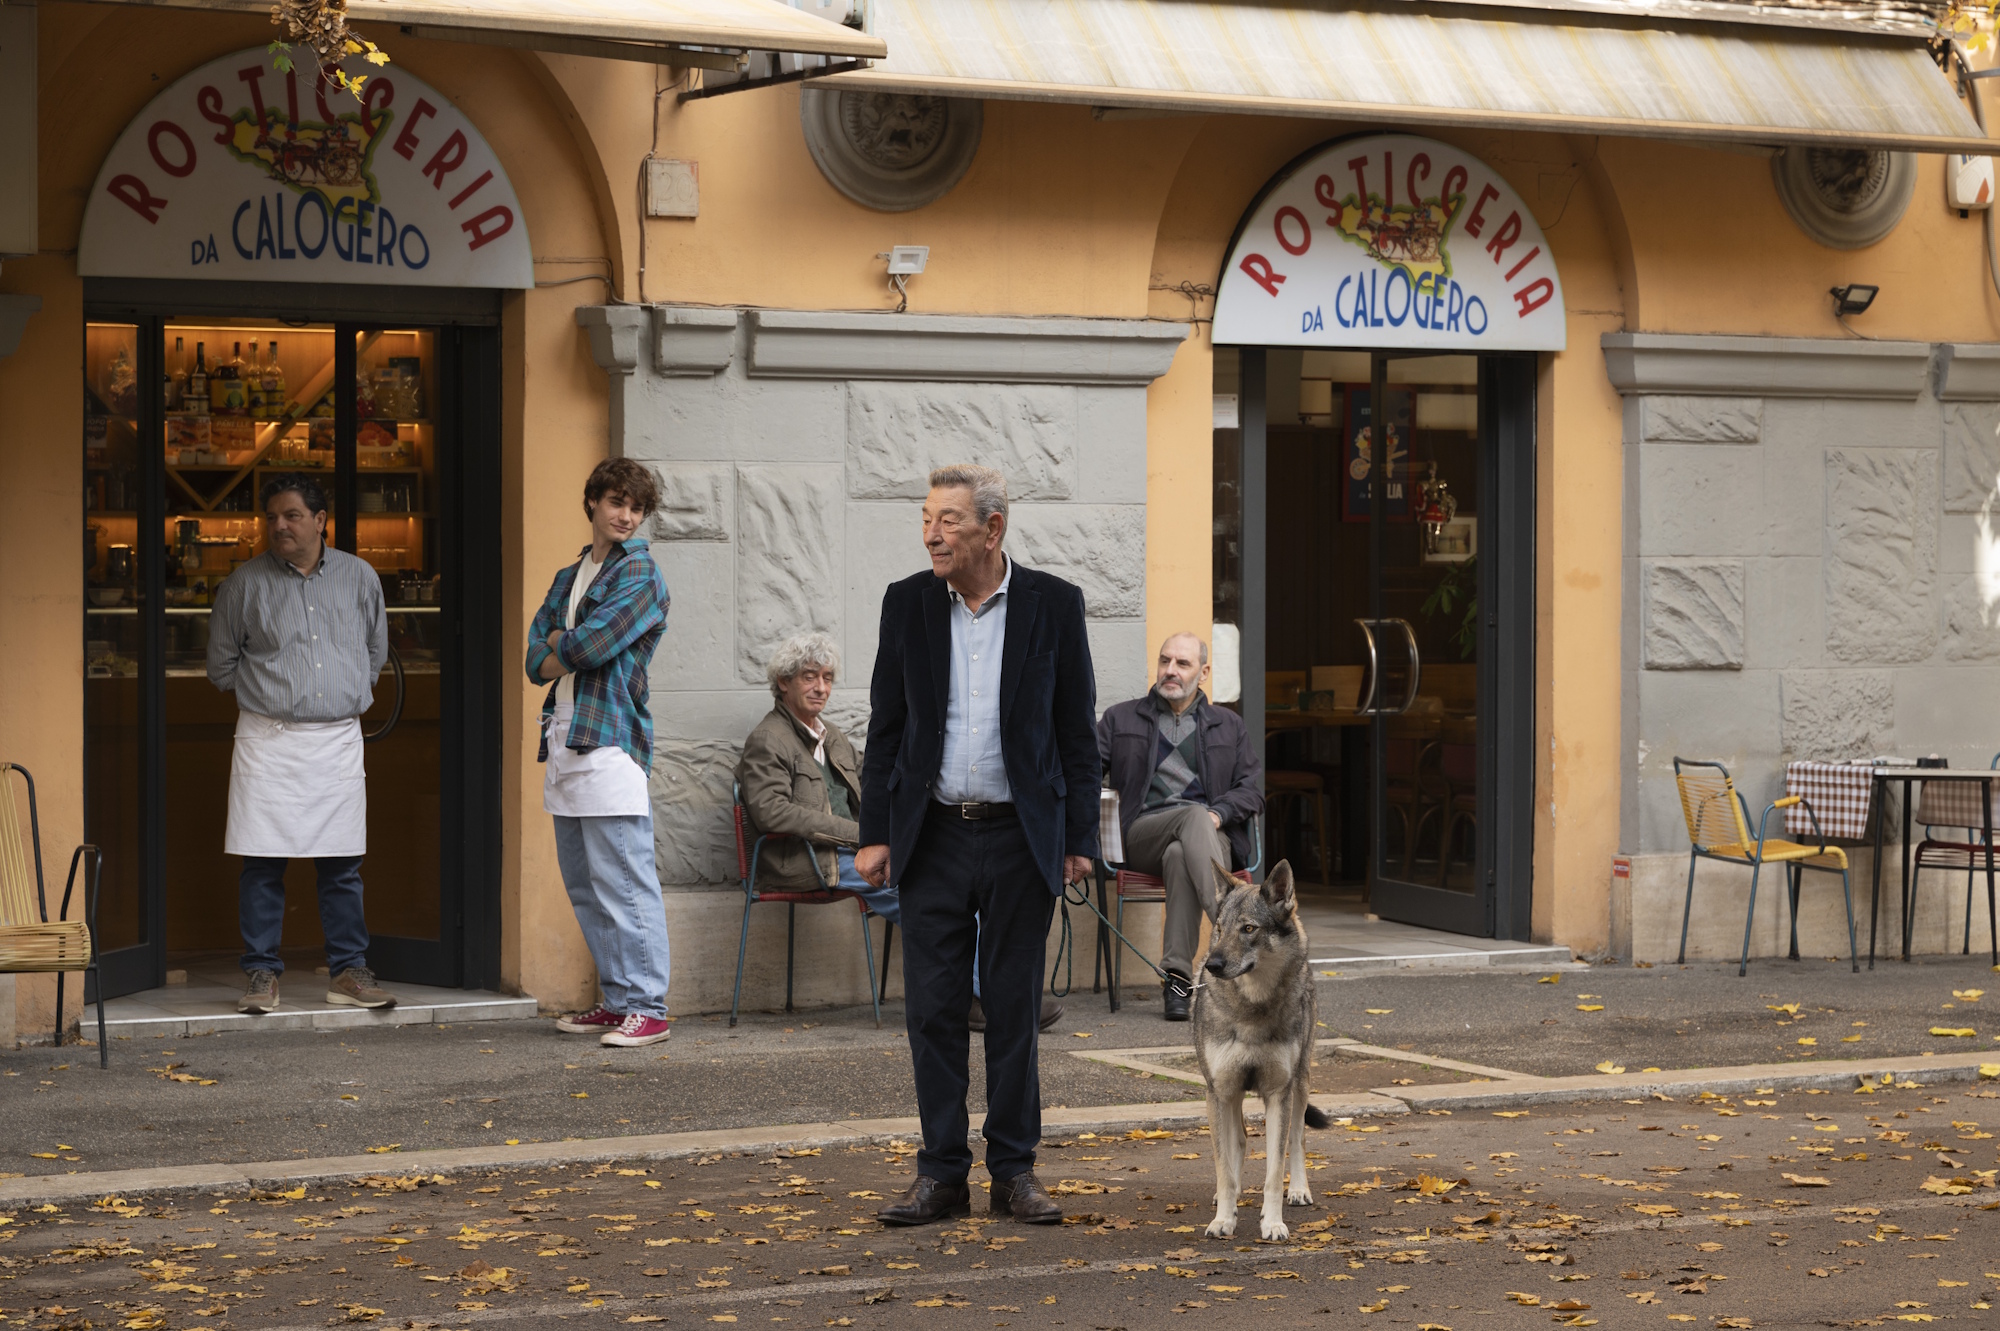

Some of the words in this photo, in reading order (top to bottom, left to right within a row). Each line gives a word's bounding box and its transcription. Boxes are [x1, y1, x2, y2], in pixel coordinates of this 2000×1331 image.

[106, 61, 515, 252] ROSTICCERIA
[191, 233, 219, 266] DA
[232, 191, 430, 270] CALOGERO
[1239, 151, 1554, 318] ROSTICCERIA
[1302, 305, 1323, 334] DA
[1335, 267, 1488, 336] CALOGERO
